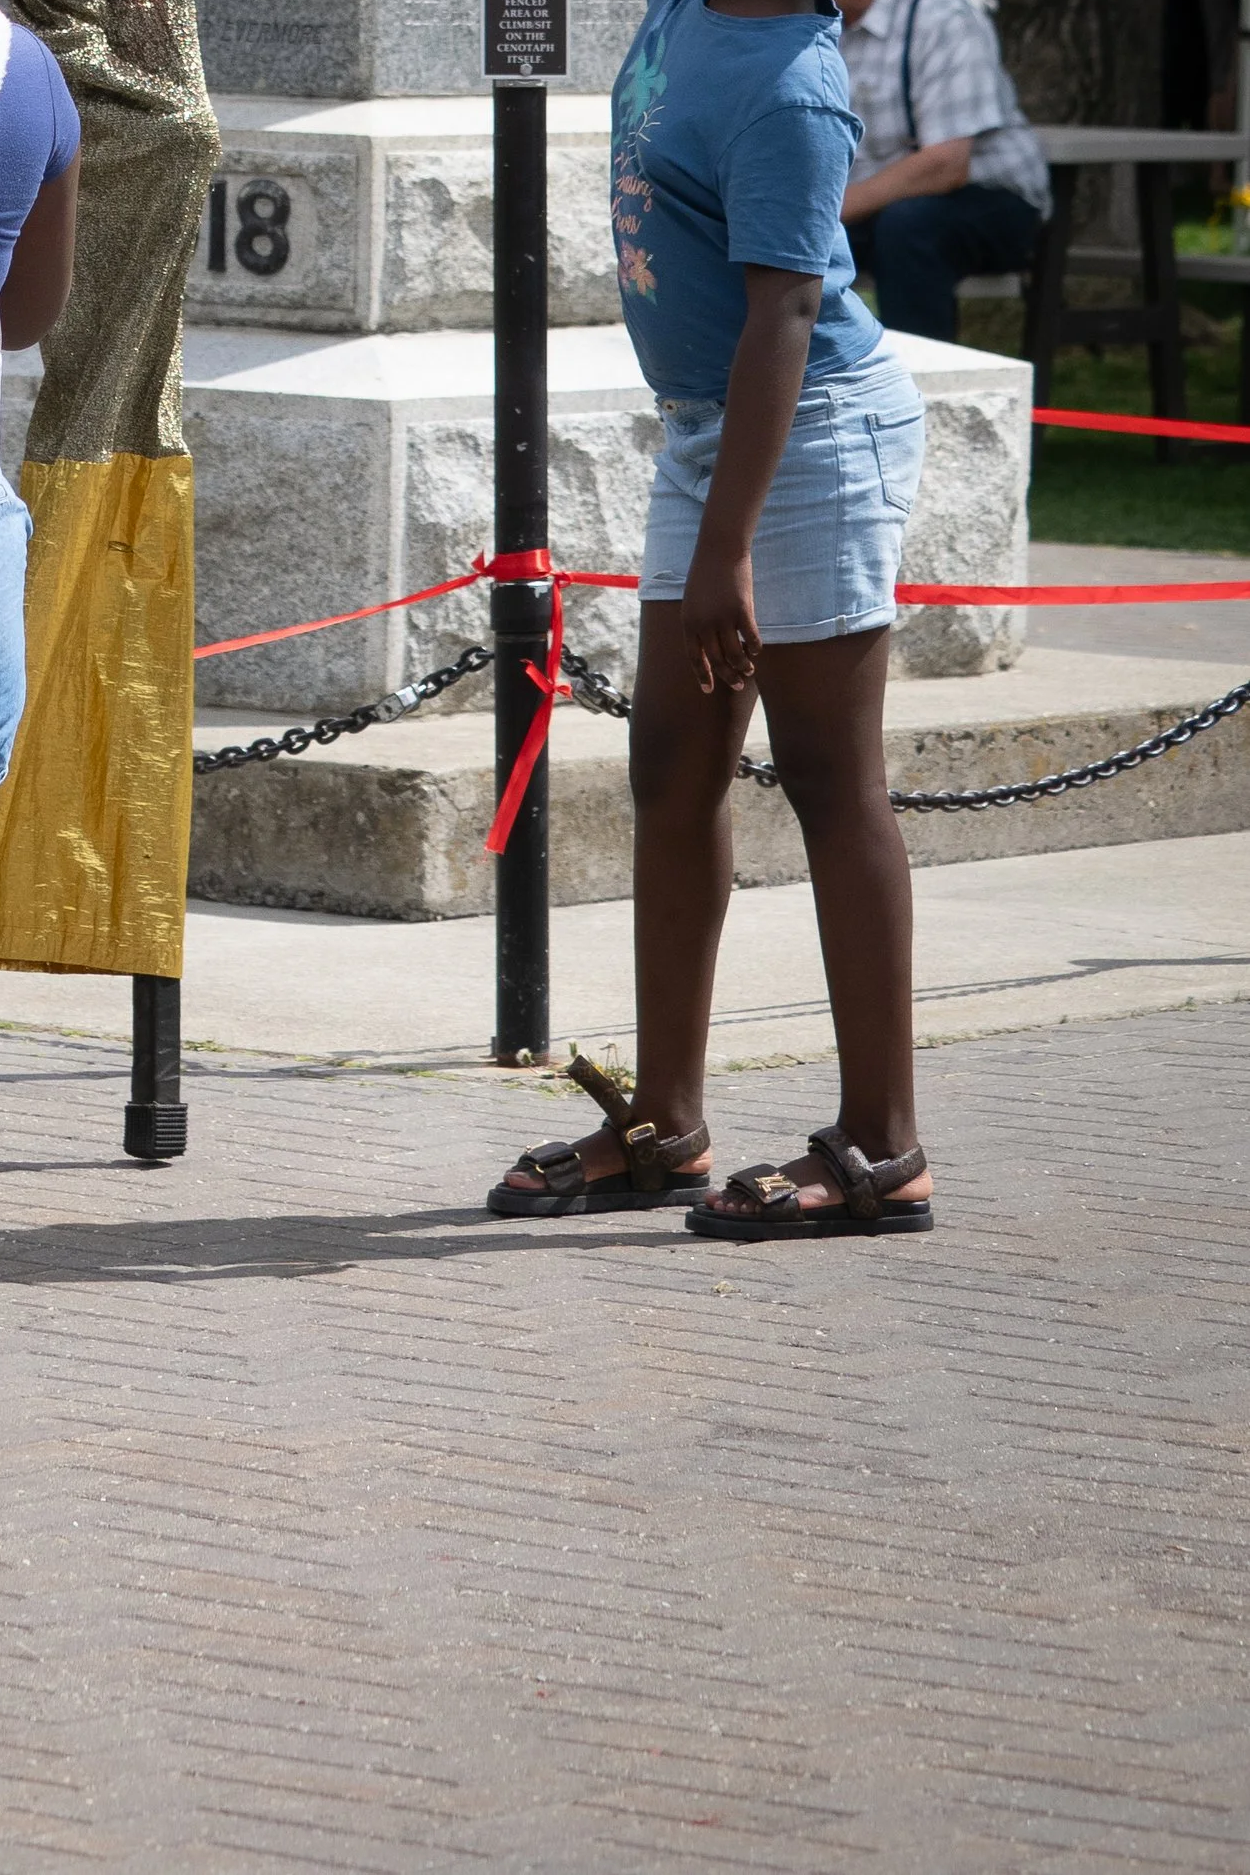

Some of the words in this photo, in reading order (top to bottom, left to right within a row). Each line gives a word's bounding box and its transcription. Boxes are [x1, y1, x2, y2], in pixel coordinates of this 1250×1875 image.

[502, 9, 531, 18] AREA
[532, 9, 550, 18] OR
[498, 20, 553, 30] CLIMB/SIT
[505, 32, 522, 41] ON
[524, 32, 547, 41] THE
[496, 43, 555, 53] CENOTAPH
[506, 55, 547, 64] ITSELF.
[207, 179, 292, 277] 18
